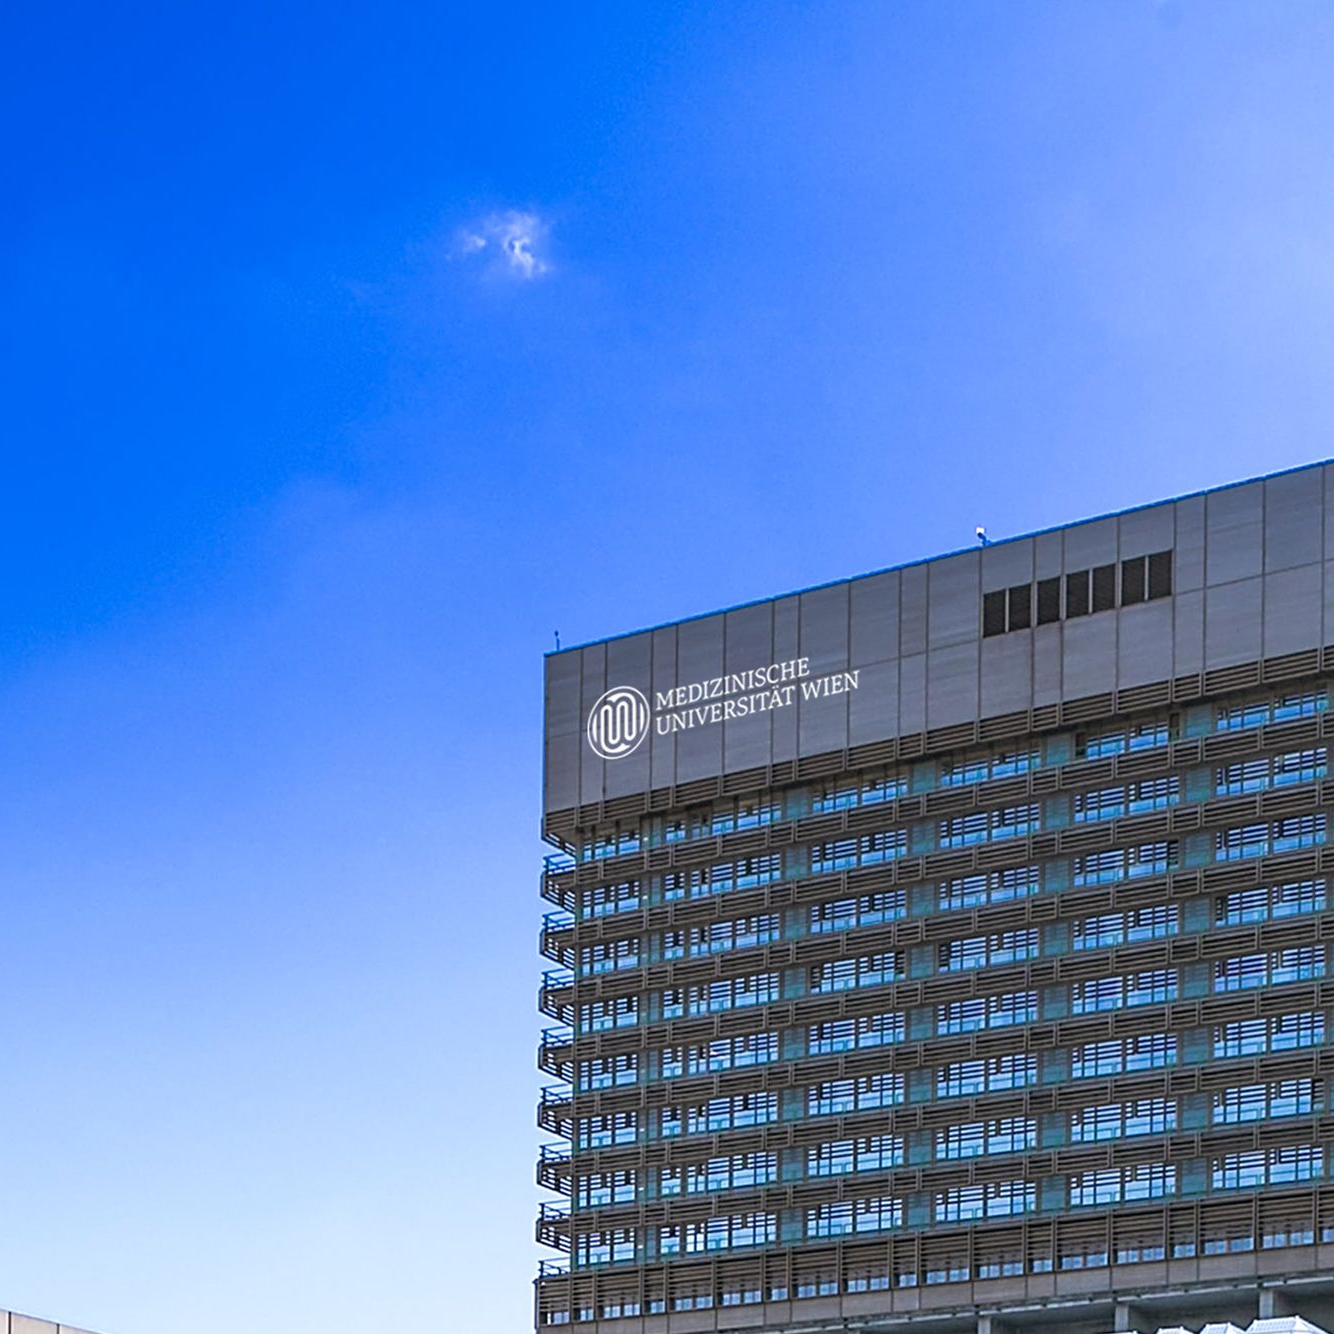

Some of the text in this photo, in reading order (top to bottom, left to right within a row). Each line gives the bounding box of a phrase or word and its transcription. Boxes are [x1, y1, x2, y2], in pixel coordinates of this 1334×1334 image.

[655, 656, 811, 711] MEDIZINISCHE
[655, 669, 861, 736] UNIVERSITÄT WIEN
